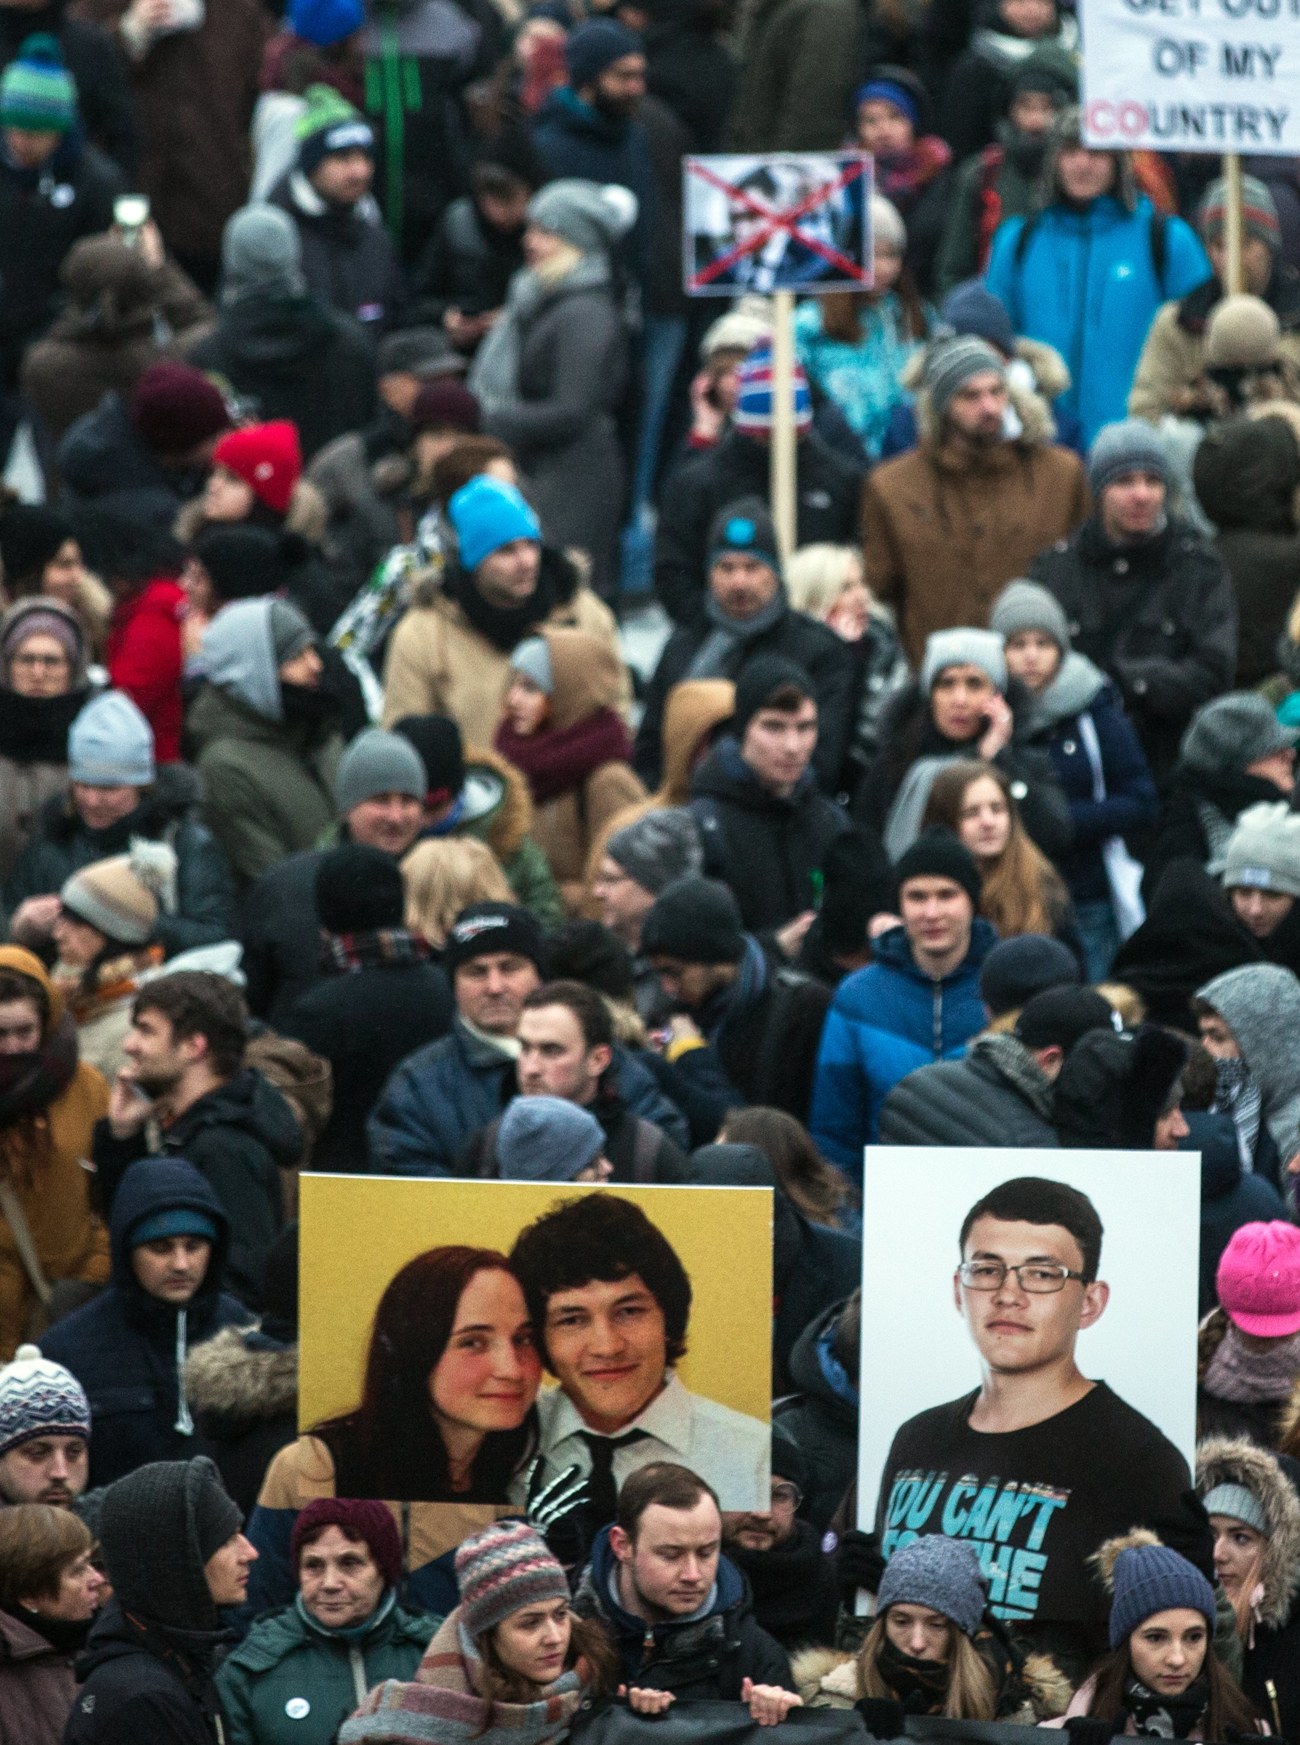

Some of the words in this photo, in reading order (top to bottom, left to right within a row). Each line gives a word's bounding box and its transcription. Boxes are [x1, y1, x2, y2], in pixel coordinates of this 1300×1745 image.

[1153, 38, 1208, 77] OF
[1221, 41, 1282, 79] MY
[1087, 100, 1289, 140] COUNTRY
[941, 1472, 1072, 1551] CAN'T
